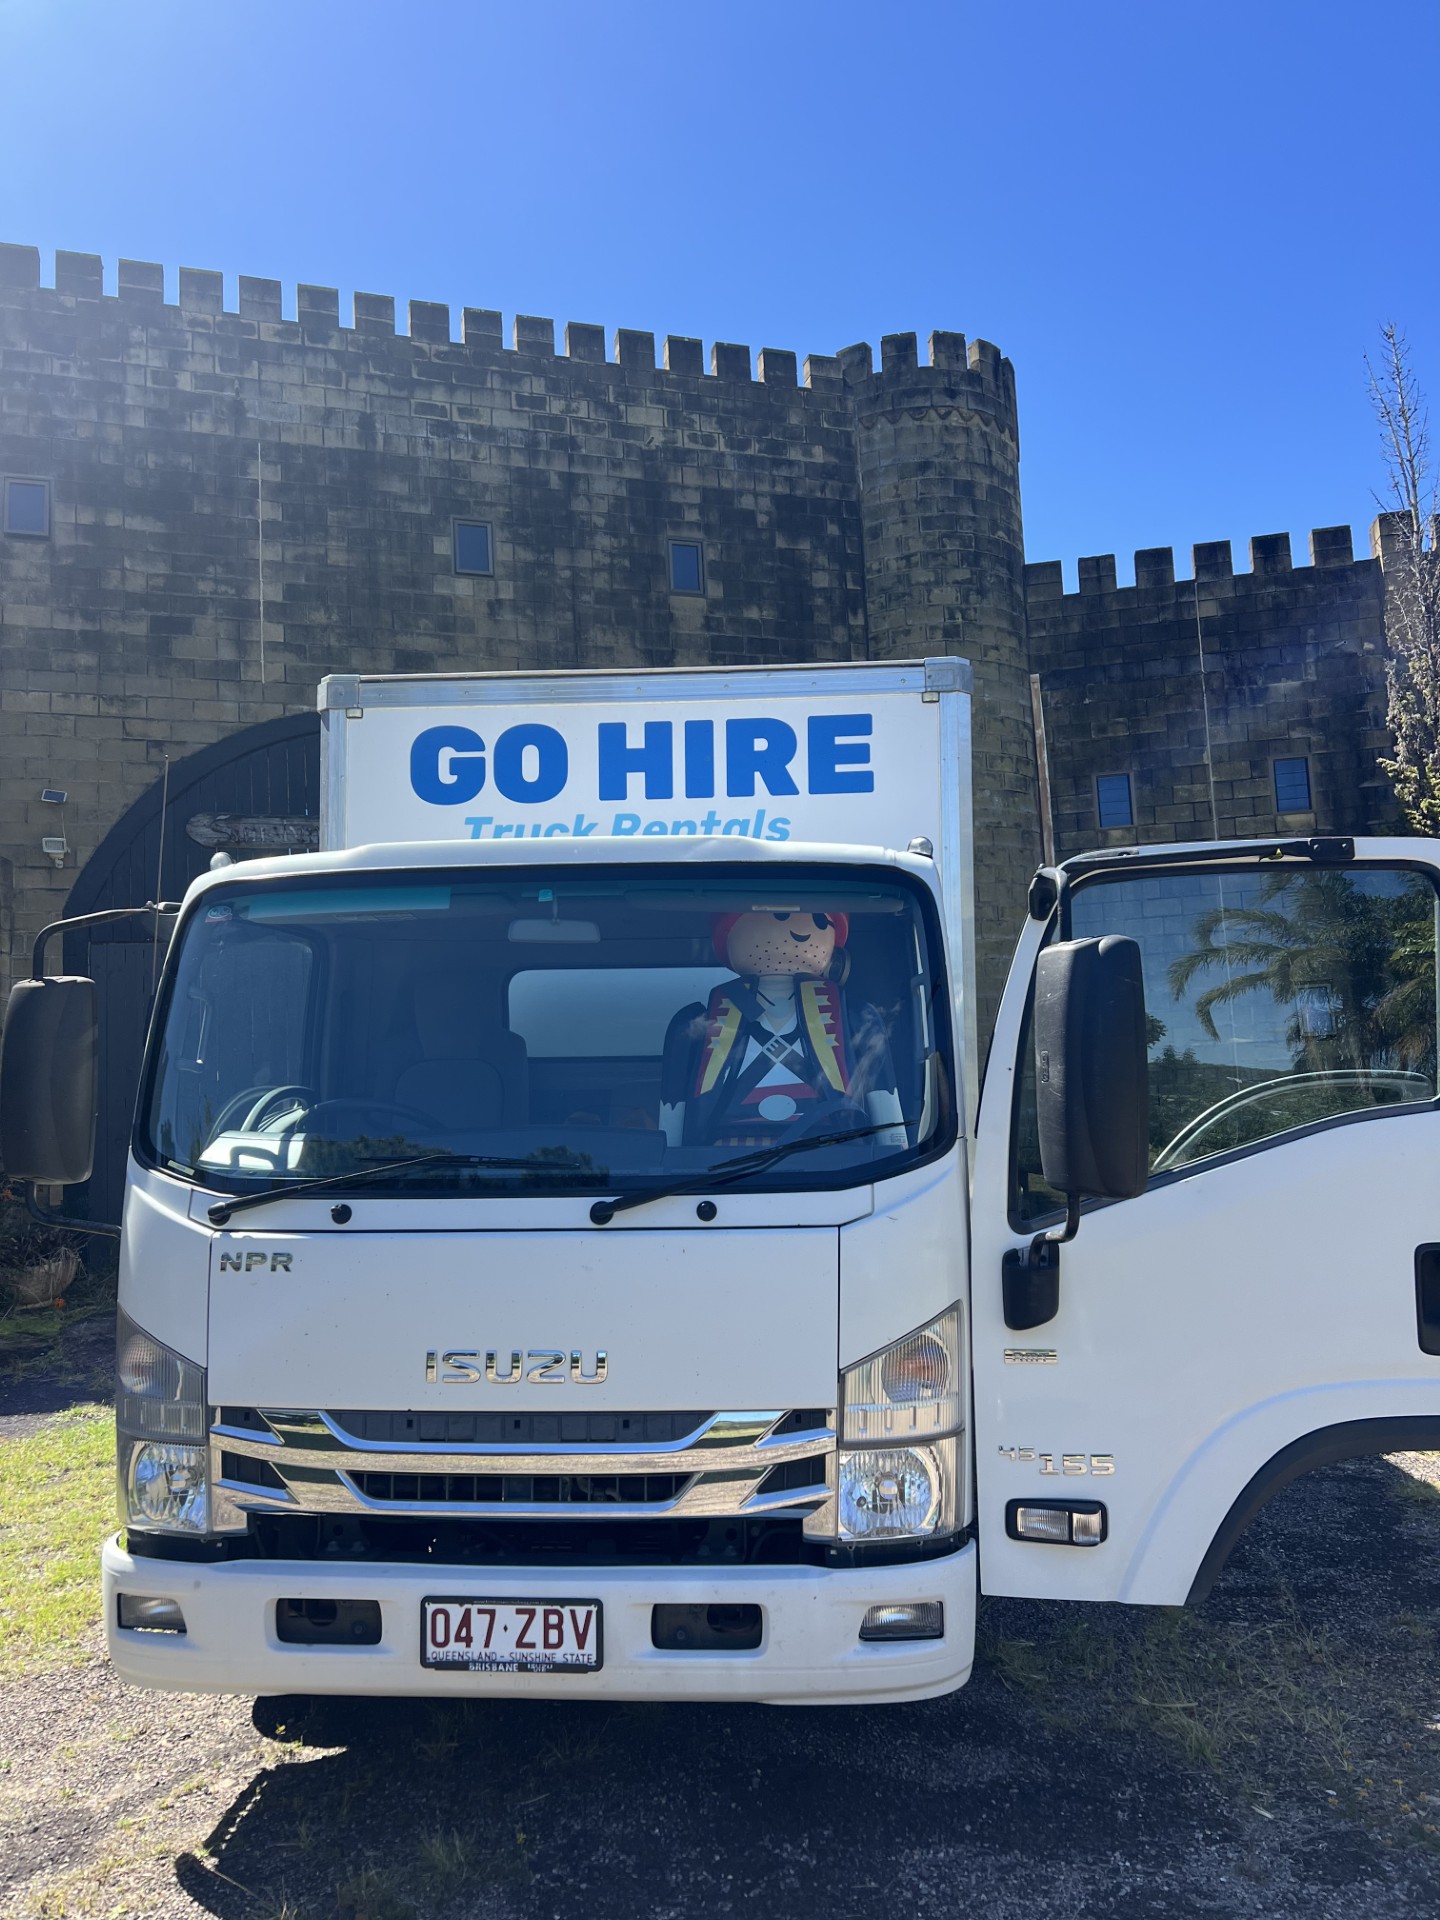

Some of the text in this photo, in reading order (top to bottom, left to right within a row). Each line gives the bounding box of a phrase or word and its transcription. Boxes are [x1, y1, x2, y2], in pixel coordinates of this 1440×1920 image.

[410, 713, 874, 805] GO HIRE
[464, 809, 792, 842] Truck Rentals
[220, 1252, 293, 1272] NPR
[426, 1350, 608, 1384] ISUZU
[1039, 1454, 1115, 1475] 155
[431, 1651, 497, 1662] QUEENSLAND
[509, 1652, 557, 1663] SUNSHINE
[563, 1653, 593, 1664] STATE
[469, 1662, 519, 1672] BRISBANE
